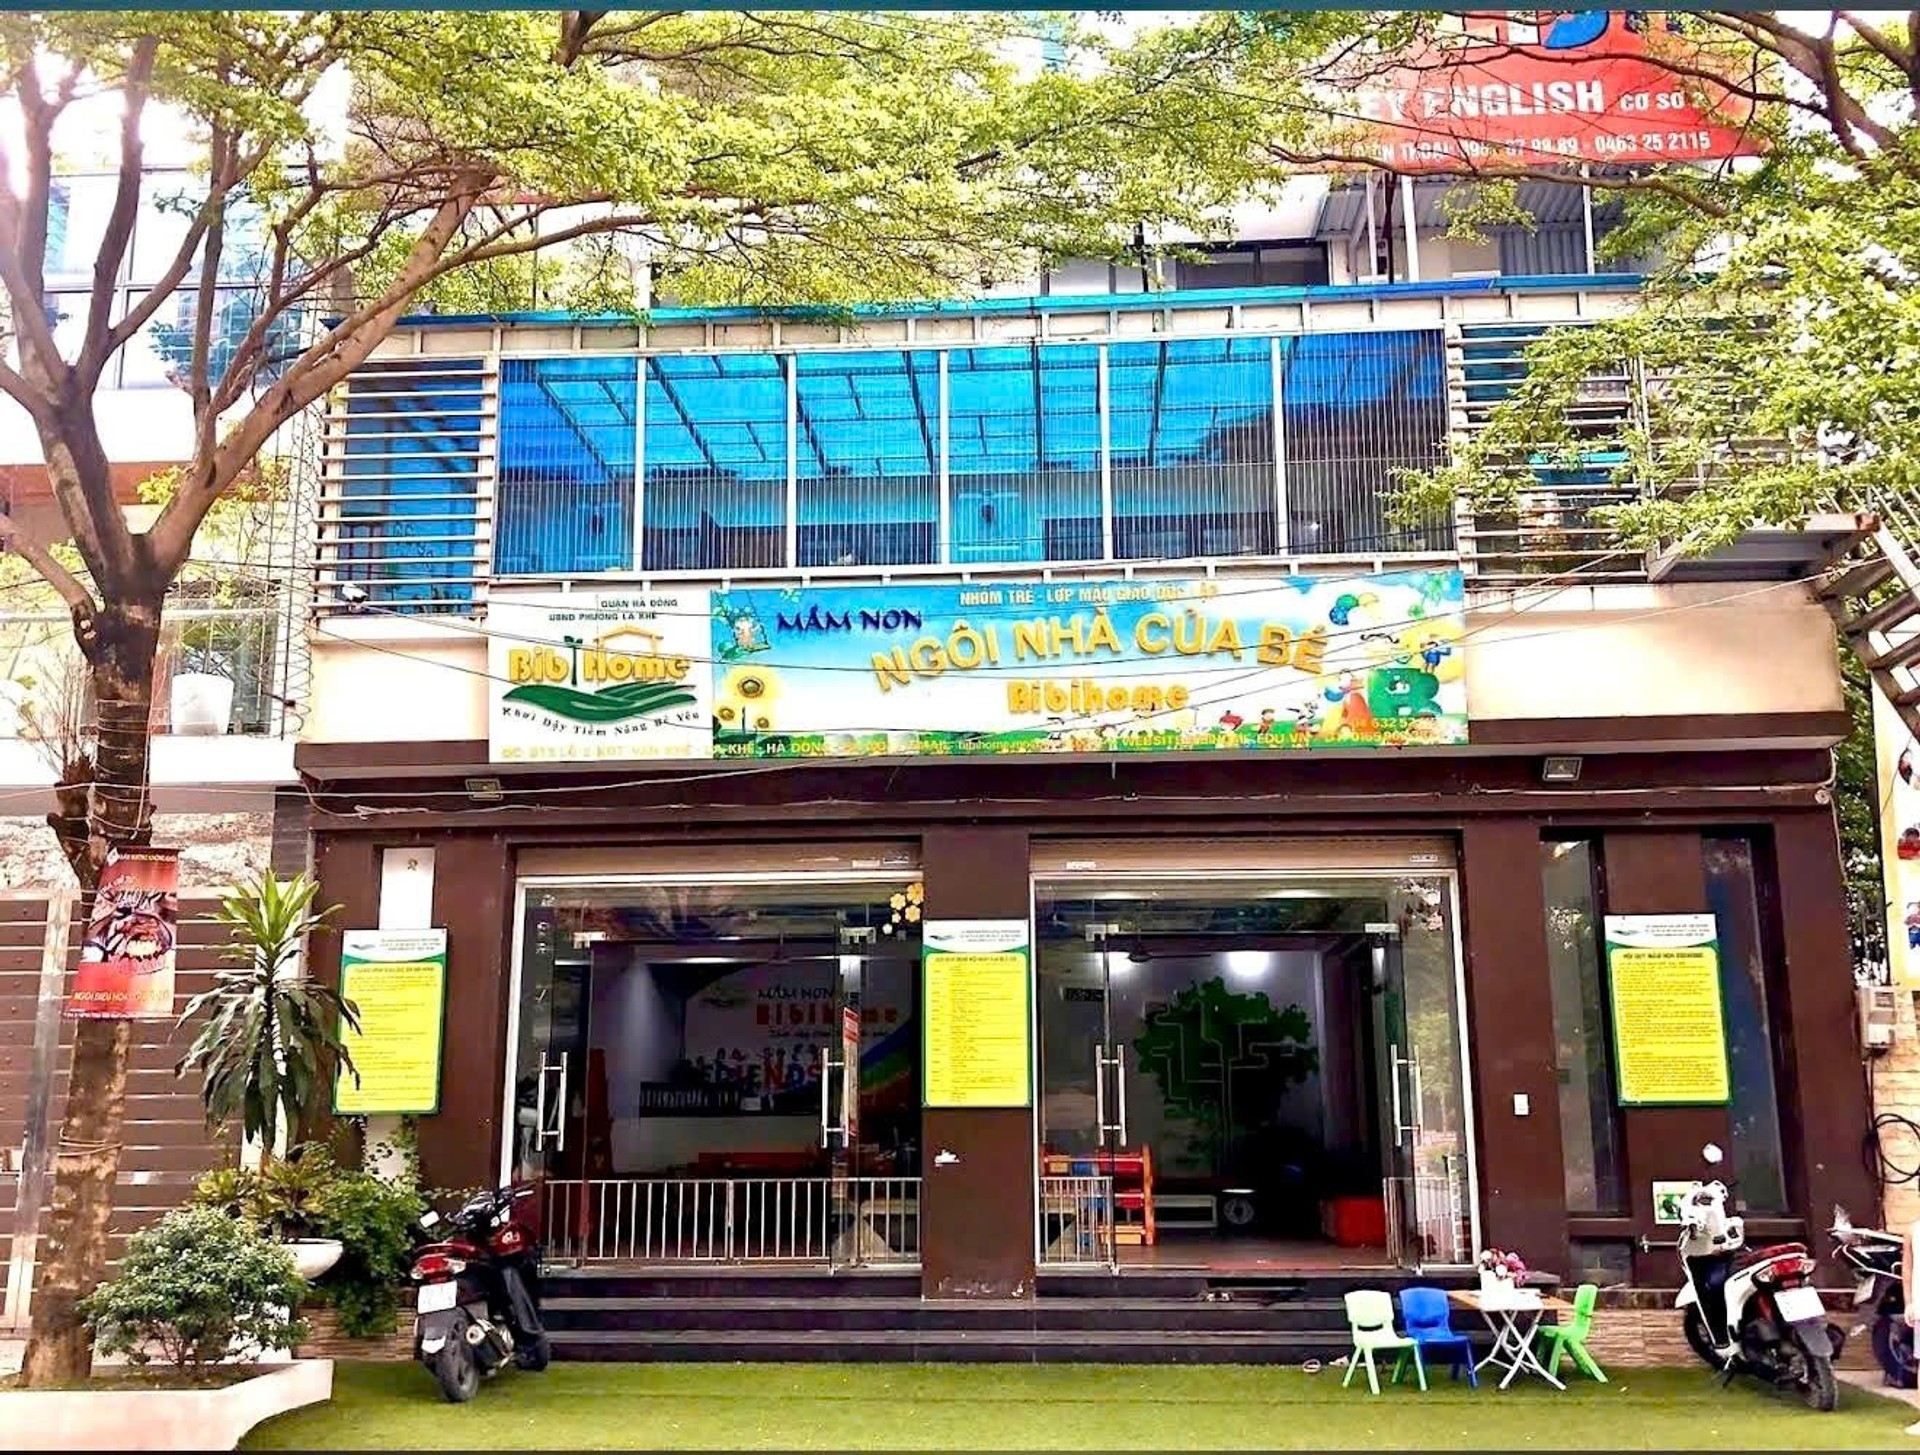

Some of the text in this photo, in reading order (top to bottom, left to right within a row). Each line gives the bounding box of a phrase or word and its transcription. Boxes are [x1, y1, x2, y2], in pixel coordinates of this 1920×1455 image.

[1423, 80, 1604, 119] ENGLISH
[1642, 133, 1664, 152] 25
[1668, 131, 1711, 151] 2115
[859, 608, 923, 631] NON
[871, 607, 1329, 692] NGÔI NHÀ CỦA BÉ
[1007, 677, 1190, 714] Bibihome
